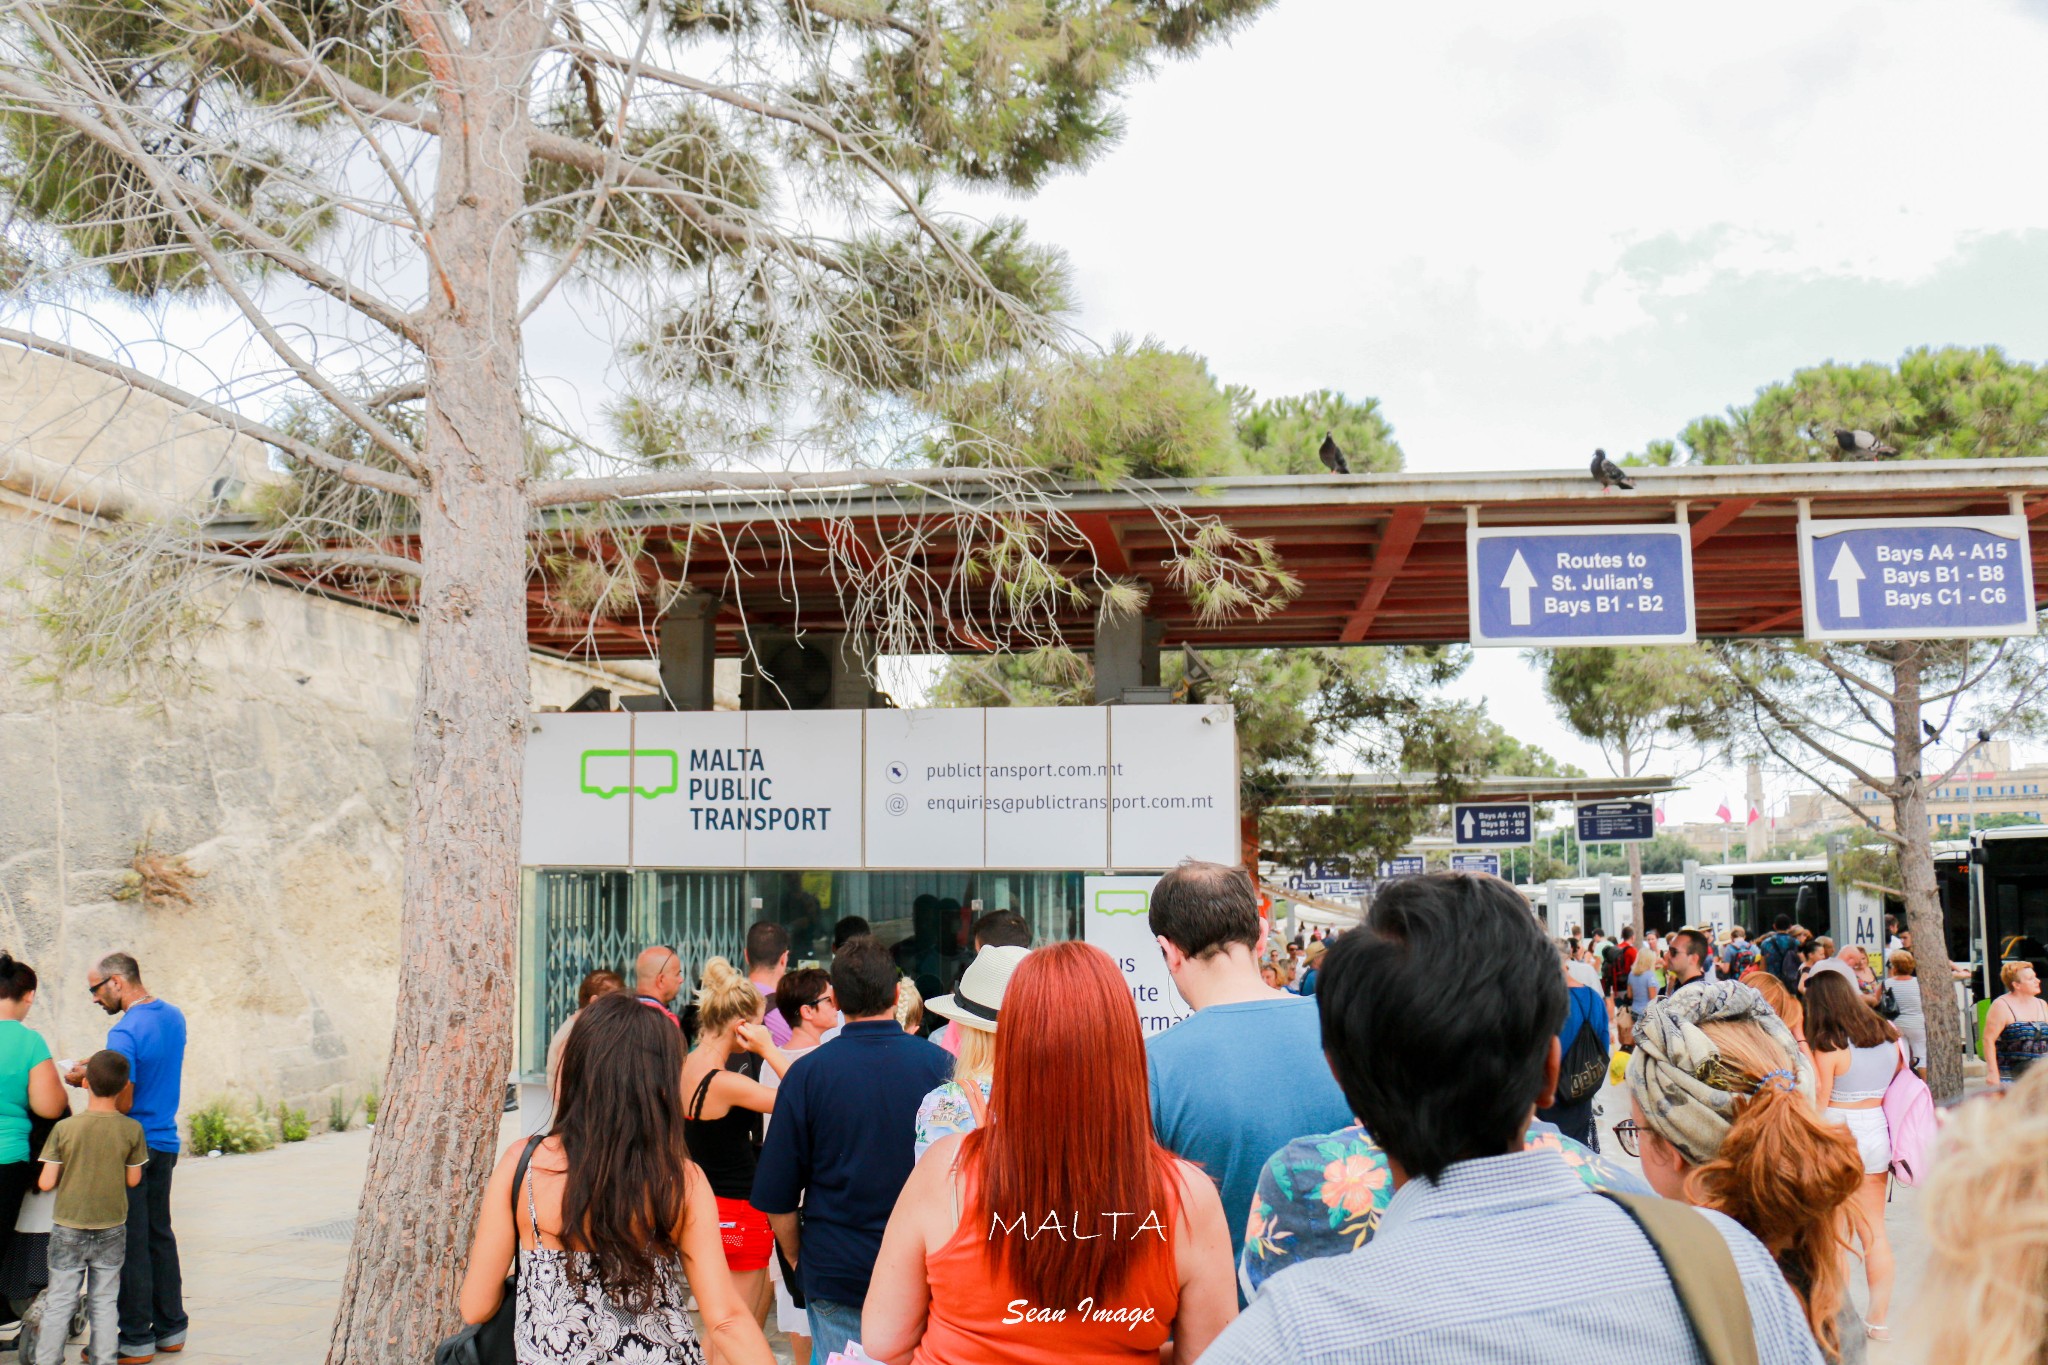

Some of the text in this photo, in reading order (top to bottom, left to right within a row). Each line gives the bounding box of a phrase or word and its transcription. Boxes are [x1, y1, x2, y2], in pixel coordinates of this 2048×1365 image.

[1557, 551, 1646, 569] Routes to
[1877, 546, 1924, 565] Bays
[1928, 544, 1954, 560] A4
[1970, 543, 2008, 559] A15
[1552, 573, 1654, 591] St. Julian's
[1883, 568, 1930, 587] Bays
[1936, 566, 1959, 582] B1
[1978, 565, 2005, 582] B8
[1544, 597, 1591, 617] Bays
[1596, 595, 1619, 612] B1
[1638, 595, 1664, 611] B2
[1885, 589, 1932, 609] Bays
[1938, 588, 1961, 605] C1
[1980, 588, 2007, 604] C6
[690, 748, 765, 771] MALTA
[927, 762, 1124, 781] publictransport.com.mt
[689, 777, 772, 801] PUBLIC
[927, 794, 1214, 814] enquiries@publictransport.com.mt
[689, 807, 832, 831] TRANSPORT
[1478, 812, 1497, 820] Bays
[1481, 820, 1498, 828] Bays
[1481, 828, 1498, 837] Bays
[1612, 887, 1623, 897] A6
[1700, 879, 1713, 890] A5
[1859, 904, 1869, 913] BAY
[1855, 916, 1874, 944] A4
